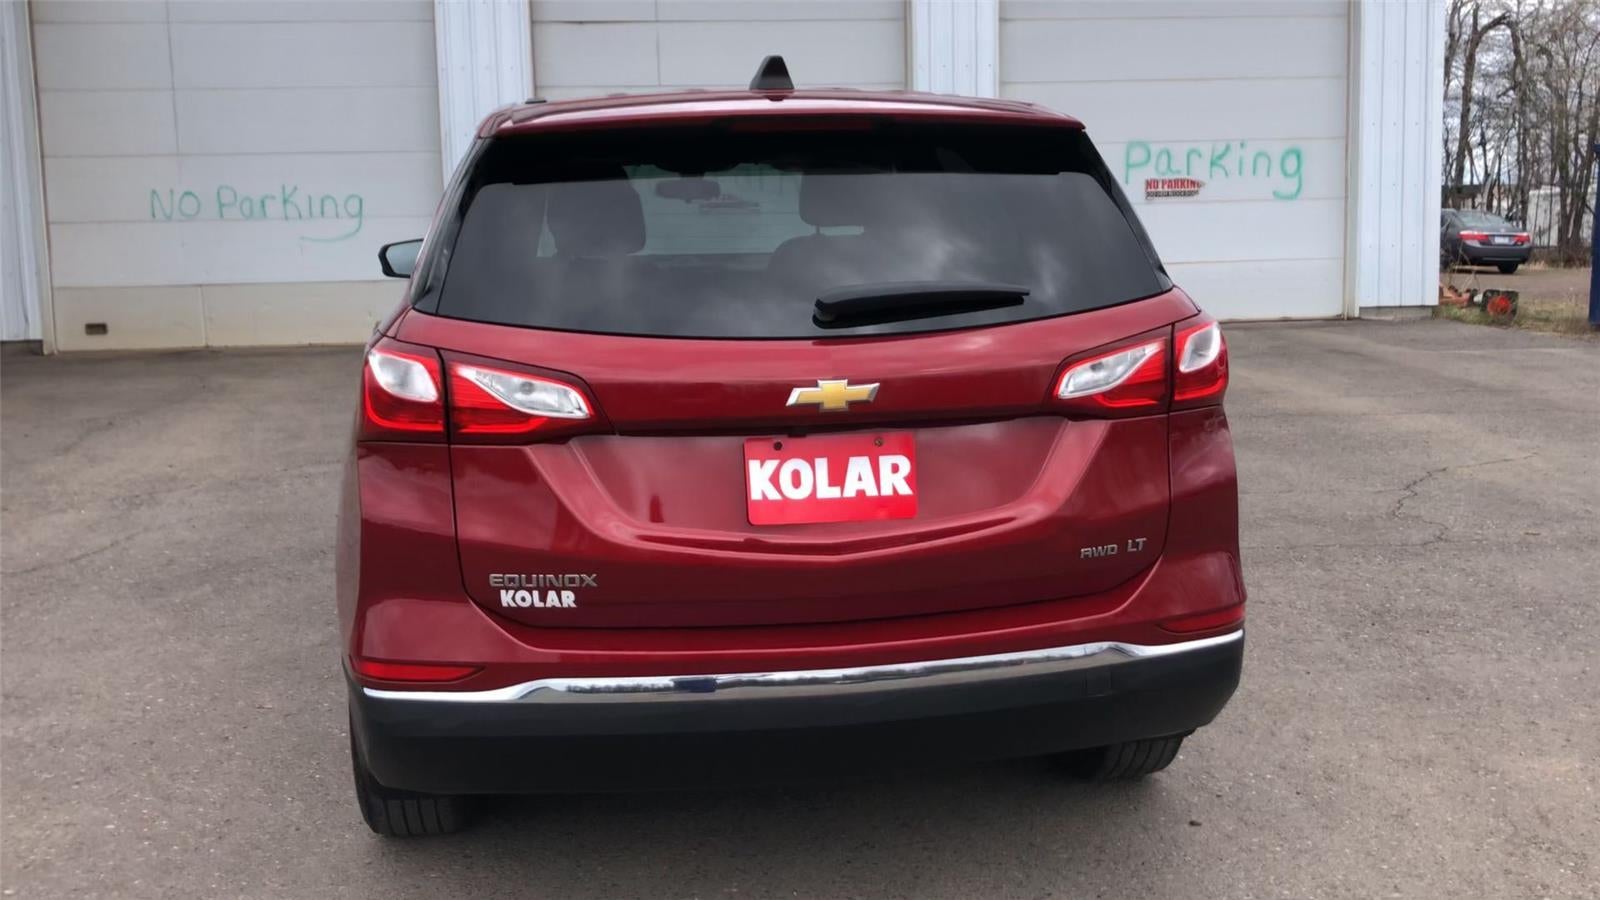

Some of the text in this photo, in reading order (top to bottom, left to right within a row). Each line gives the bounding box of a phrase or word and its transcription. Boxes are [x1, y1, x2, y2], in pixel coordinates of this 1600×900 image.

[1146, 179, 1159, 190] NO
[748, 454, 913, 501] KOLAR
[1080, 537, 1147, 559] AWD LT
[489, 573, 598, 588] EQUINOX
[500, 589, 577, 608] KOLAR
